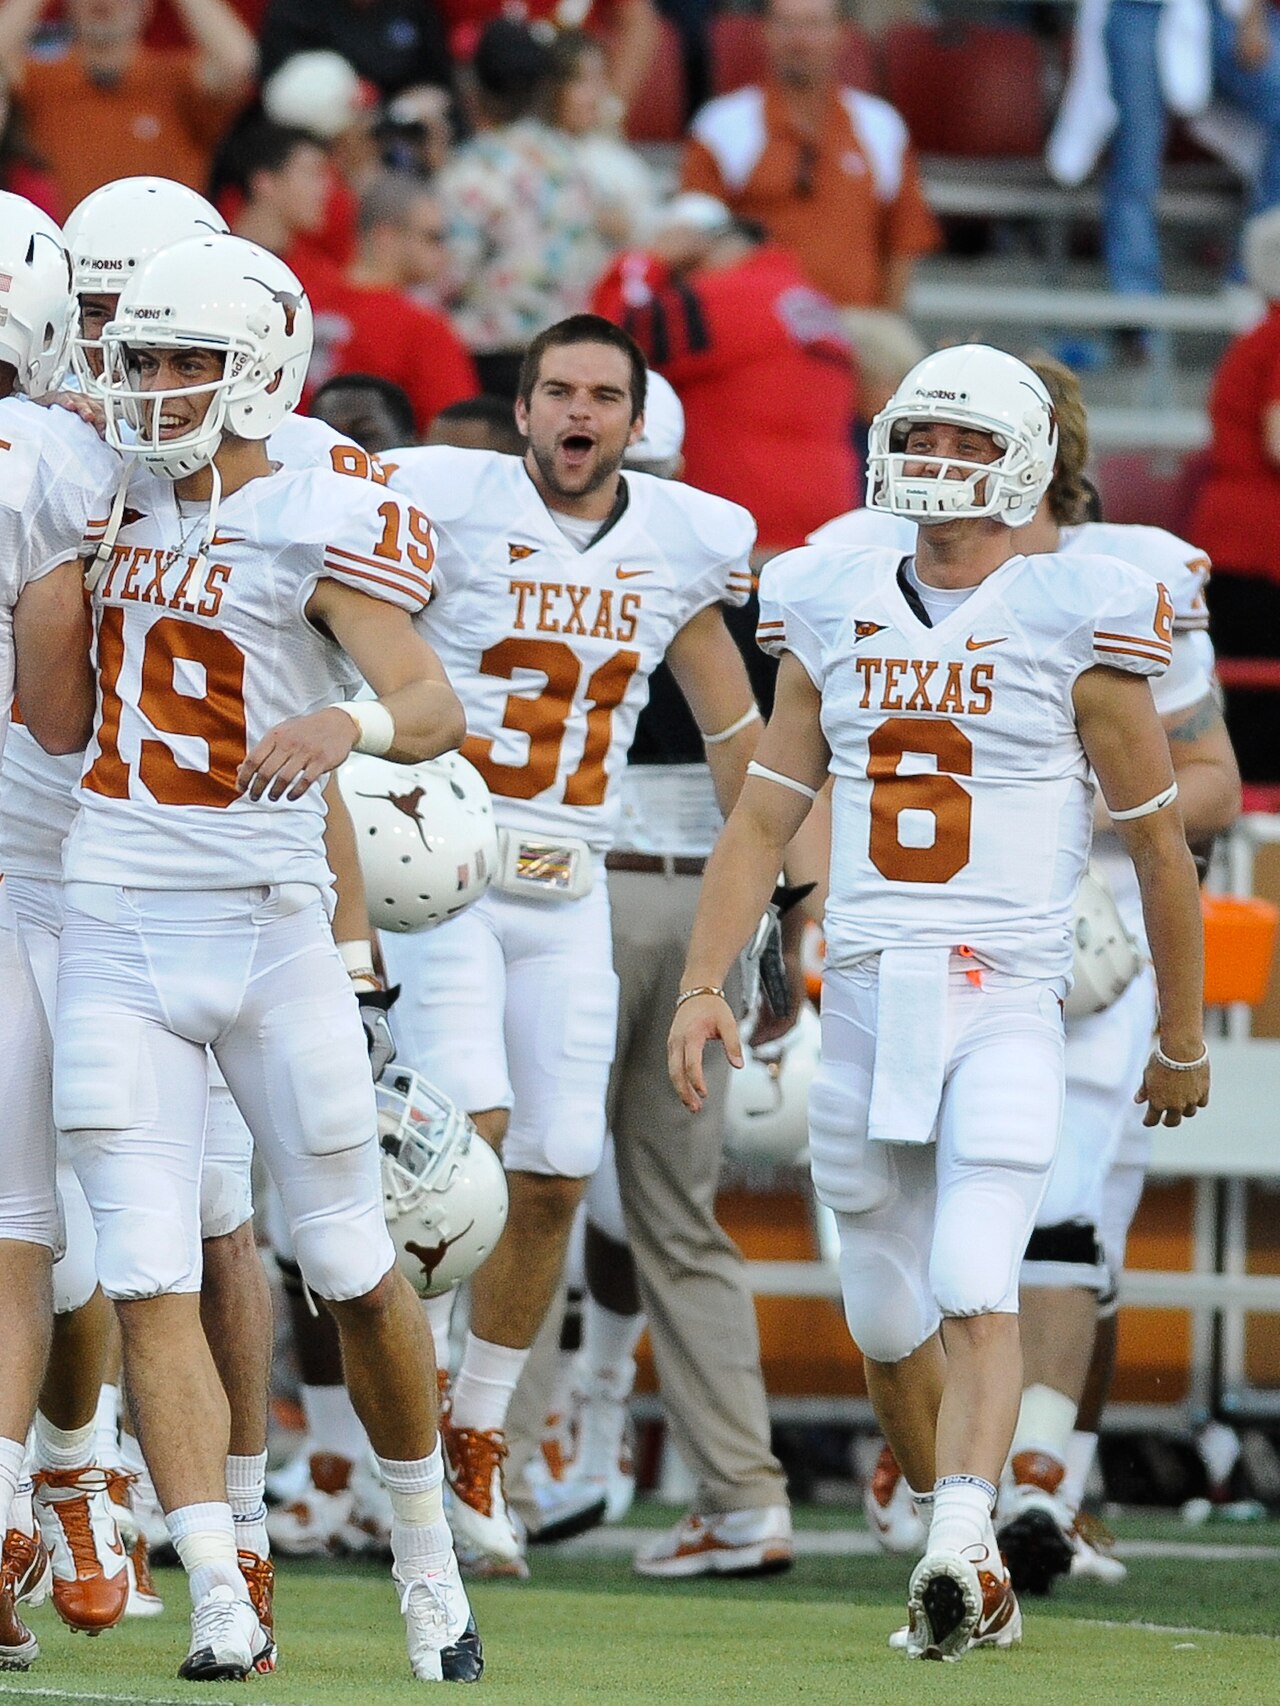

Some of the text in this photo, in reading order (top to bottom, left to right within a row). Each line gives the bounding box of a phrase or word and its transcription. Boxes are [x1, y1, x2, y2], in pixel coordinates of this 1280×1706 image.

[373, 501, 435, 574] 19
[102, 545, 232, 618] TEXAS
[509, 580, 642, 643] TEXAS
[80, 604, 248, 809] 19
[458, 636, 641, 806] 31
[855, 657, 994, 715] TEXAS
[866, 717, 973, 884] 6
